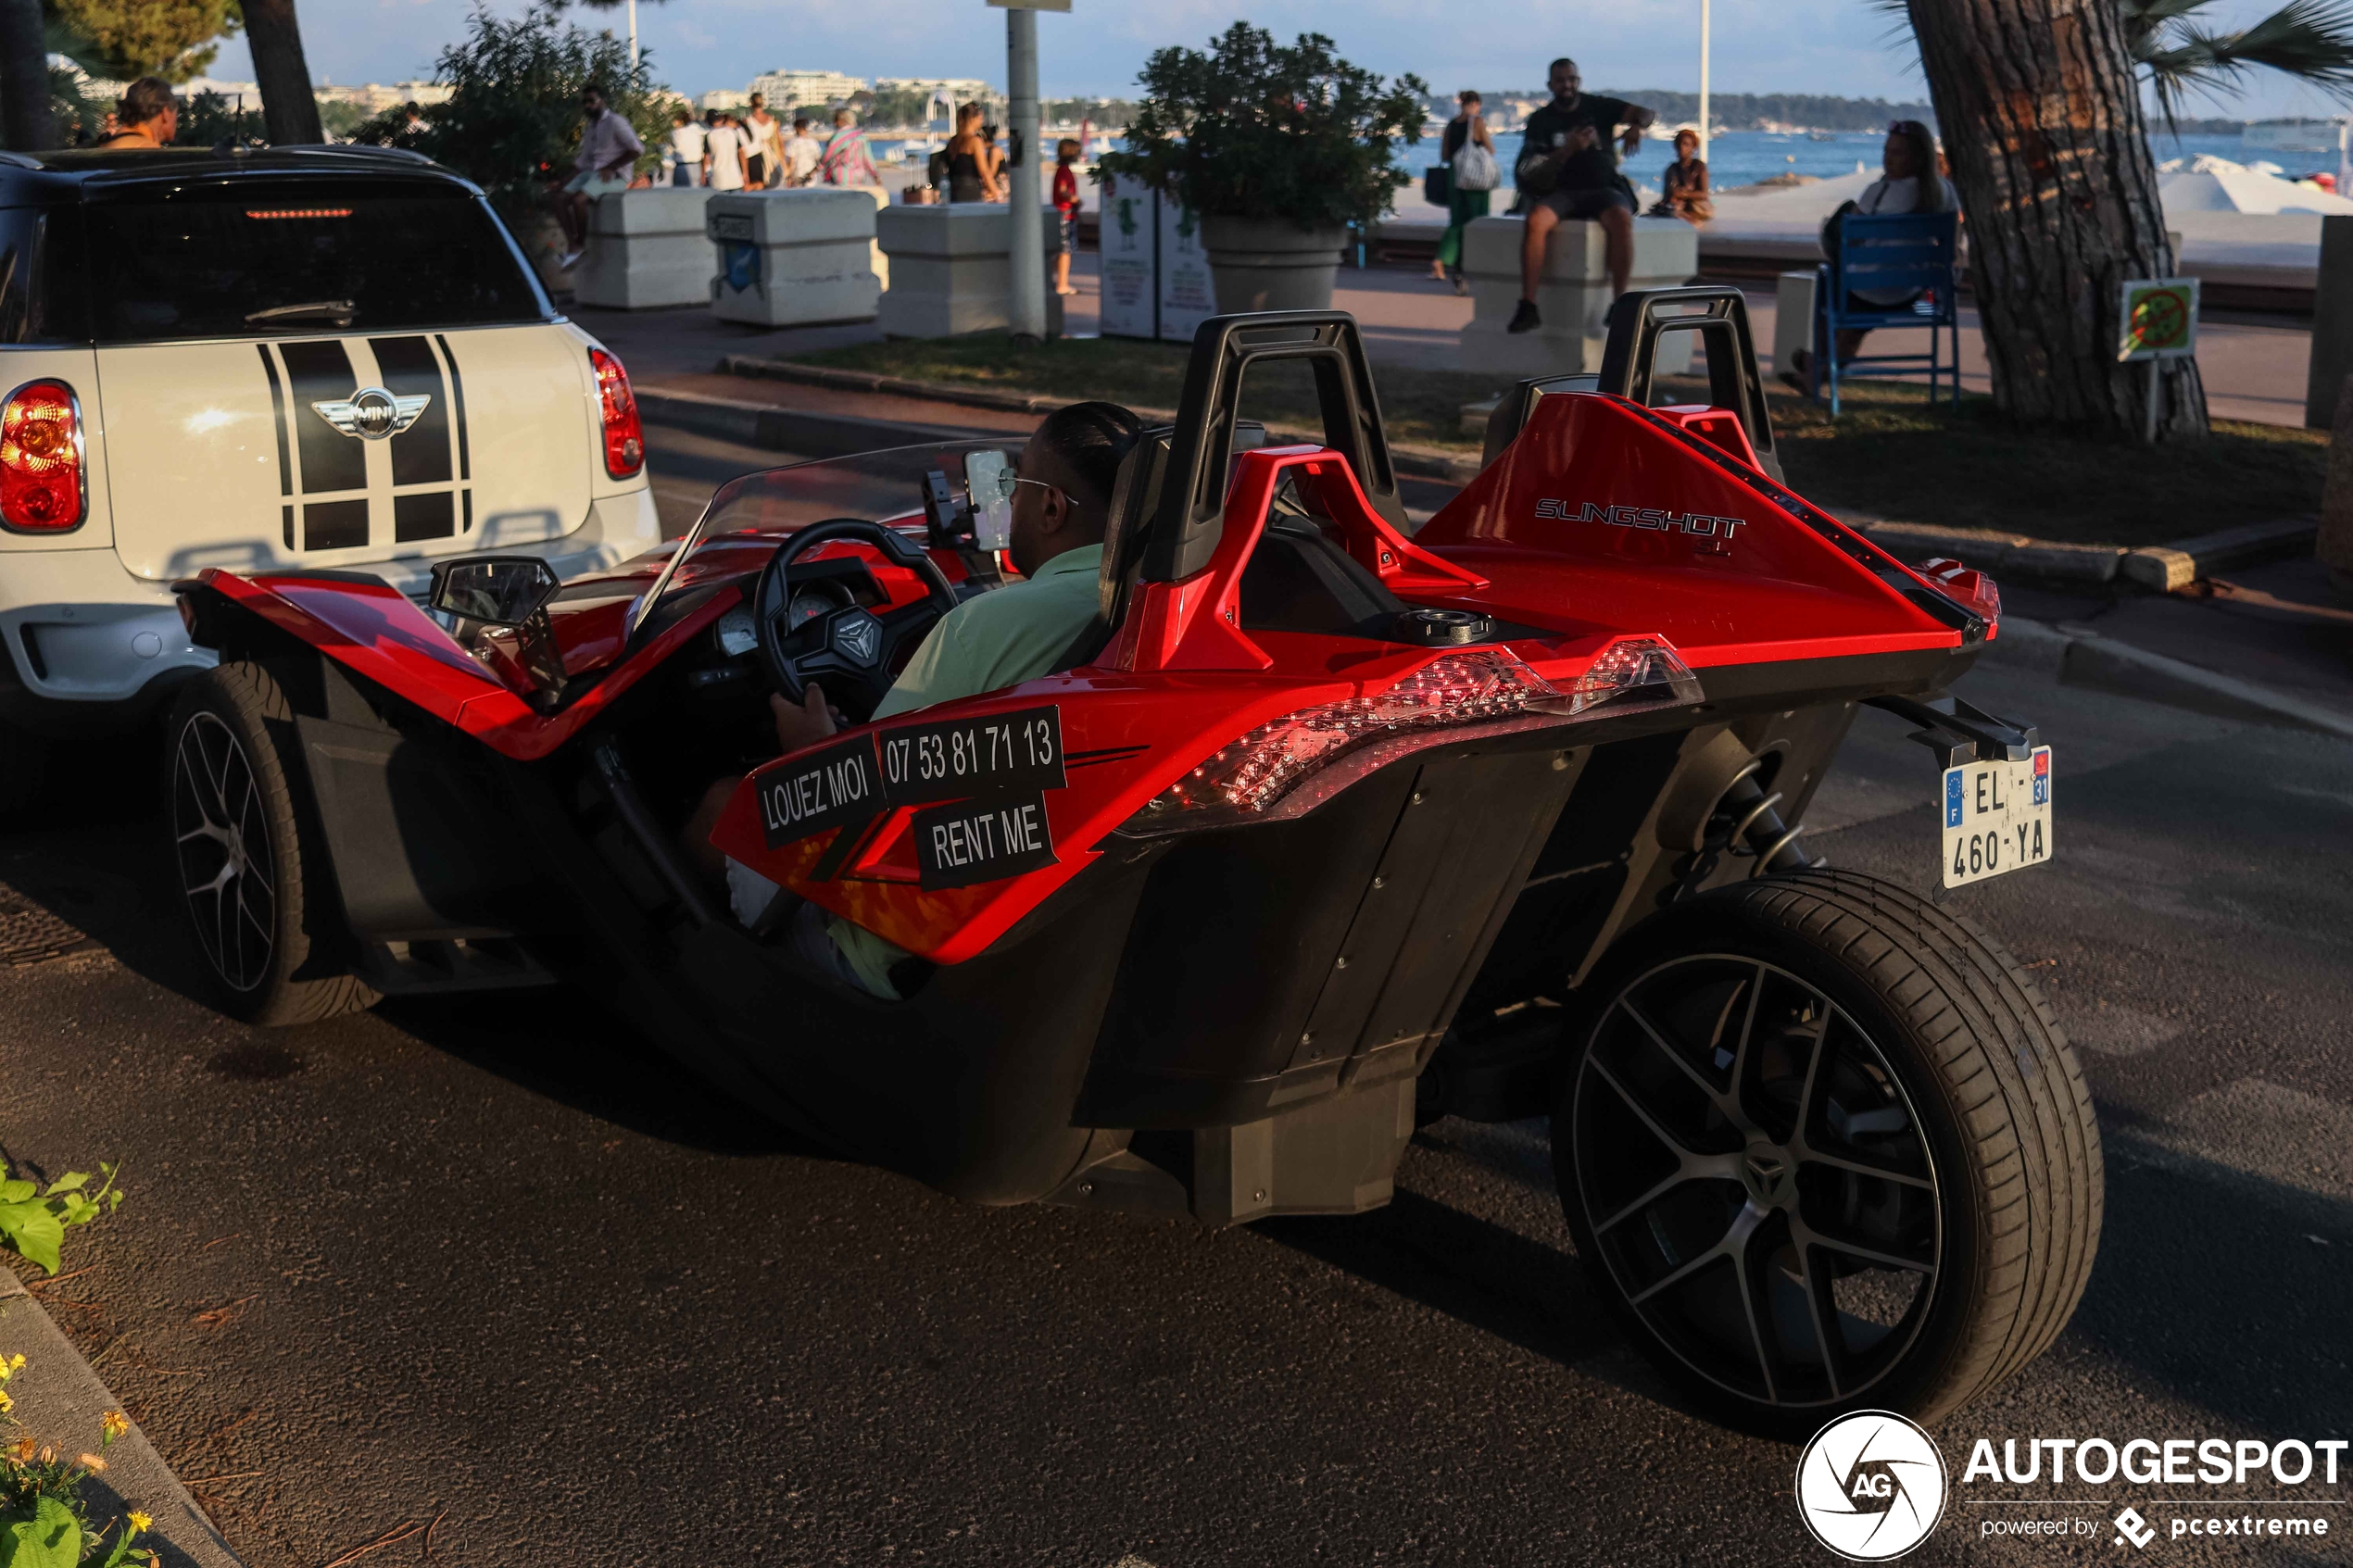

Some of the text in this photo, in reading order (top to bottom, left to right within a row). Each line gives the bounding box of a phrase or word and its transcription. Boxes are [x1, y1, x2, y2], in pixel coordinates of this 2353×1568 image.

[355, 406, 393, 421] MINI
[1535, 498, 1746, 538] SLINGSHOT
[1694, 539, 1730, 557] SL
[887, 719, 1053, 784] 07 53 81 71 13
[763, 755, 869, 830] LOUEZ MOI
[2034, 778, 2047, 801] 31
[1951, 808, 1957, 822] F
[933, 804, 1042, 869] RENT ME
